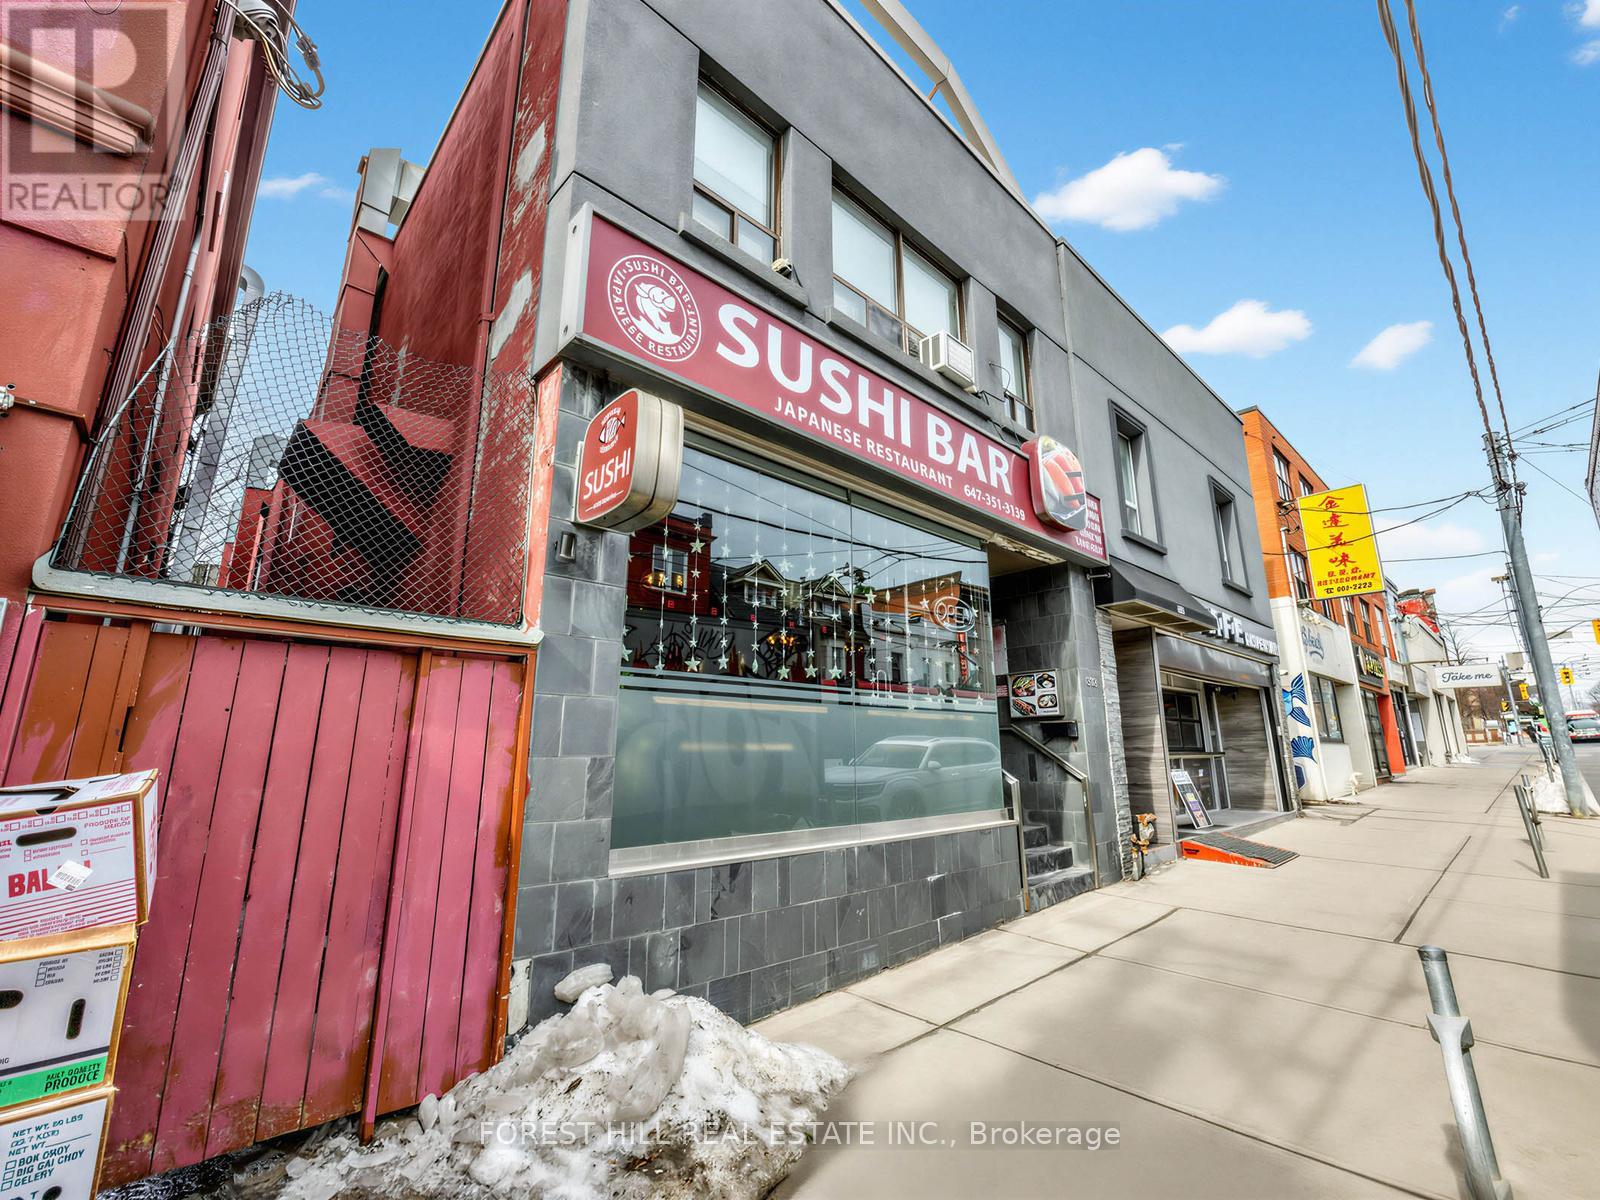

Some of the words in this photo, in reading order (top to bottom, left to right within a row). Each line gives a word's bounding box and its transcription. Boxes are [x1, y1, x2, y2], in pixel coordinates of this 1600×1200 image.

[625, 261, 665, 278] SUSHI
[716, 303, 911, 448] SUSHI
[927, 412, 1012, 496] BAR
[774, 396, 862, 449] JAPANESE
[866, 438, 953, 489] RESTAURANT
[583, 447, 631, 500] SUSHI
[963, 484, 1026, 521] 647-351-3139
[14, 1168, 54, 1187] CELERY
